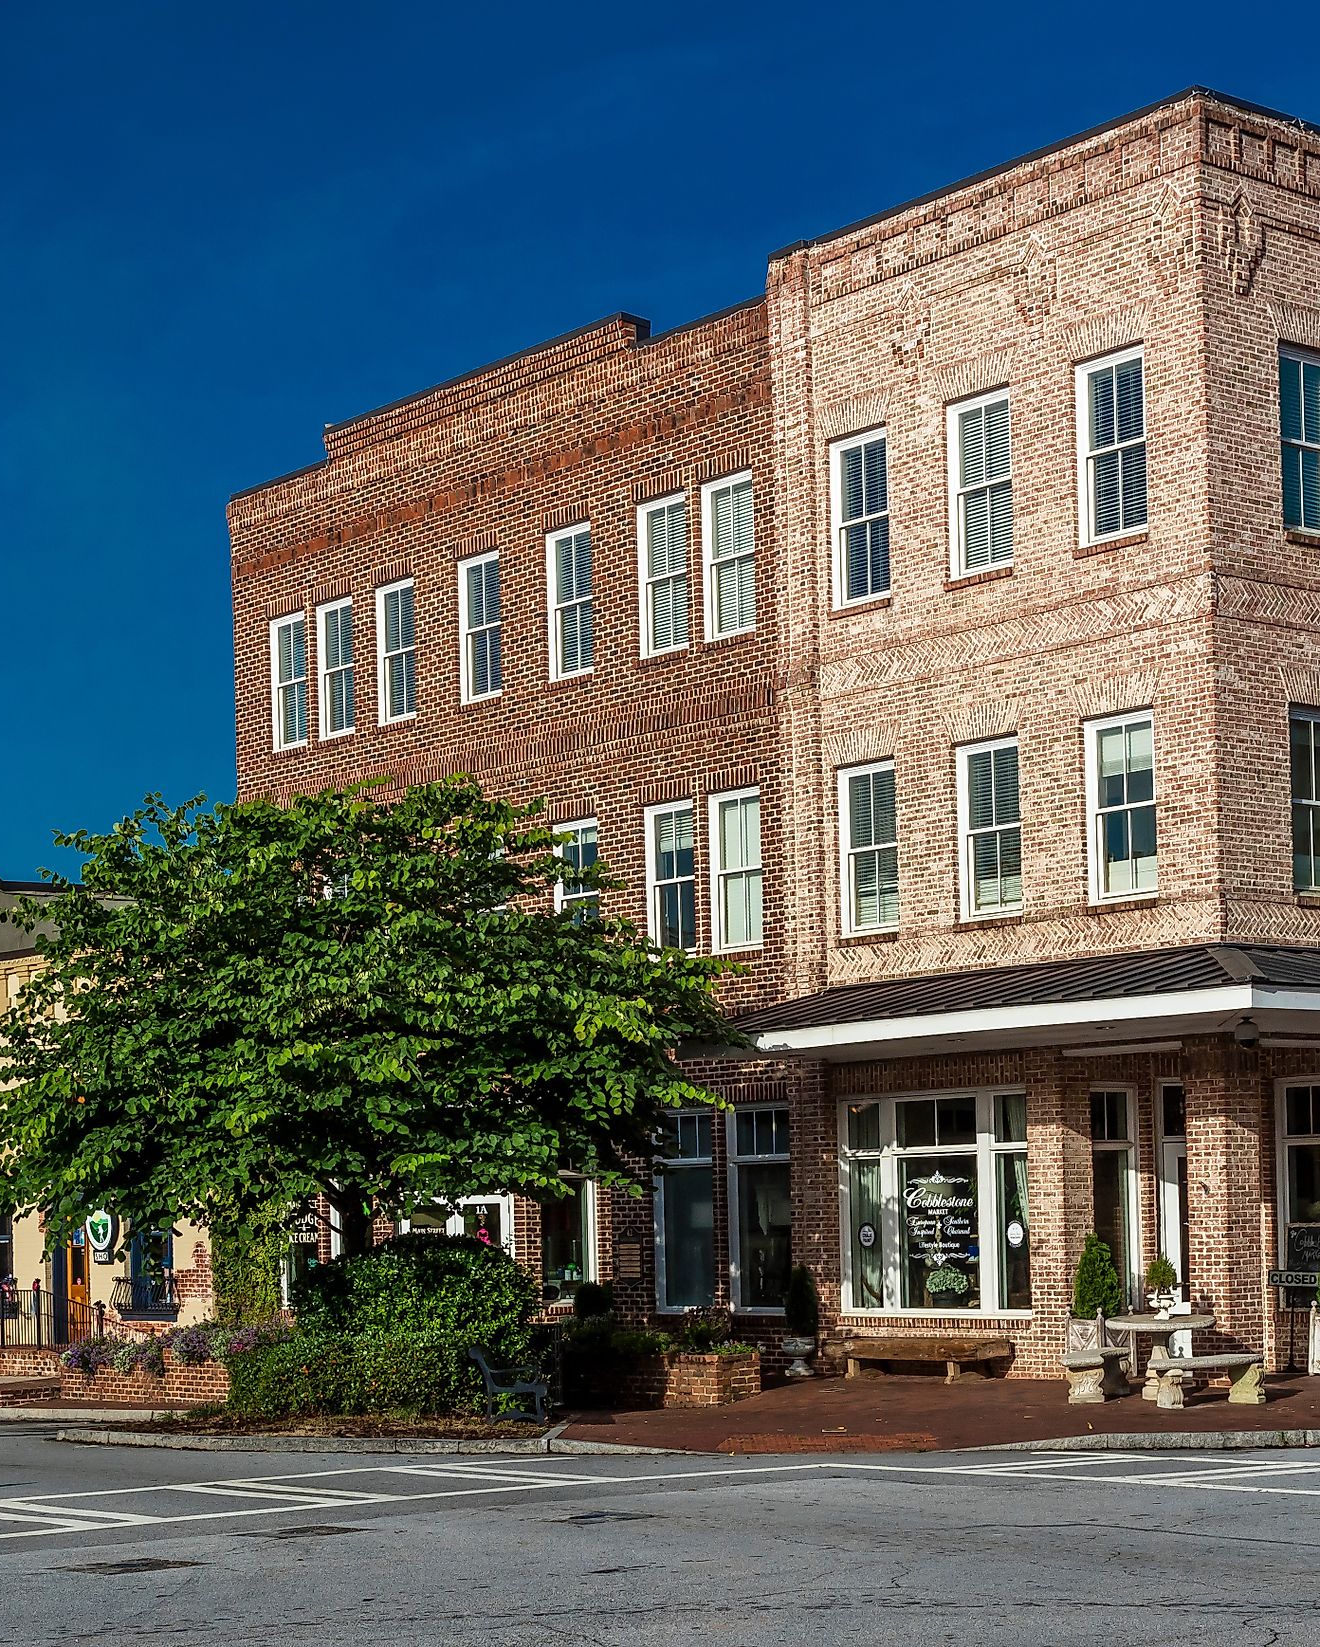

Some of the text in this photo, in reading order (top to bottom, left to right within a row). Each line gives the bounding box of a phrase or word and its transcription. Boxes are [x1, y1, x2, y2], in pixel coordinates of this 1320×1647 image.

[902, 1187, 974, 1208] Cobblestone
[475, 1205, 489, 1215] 1A
[927, 1208, 949, 1216] MARKET
[939, 1241, 960, 1250] Boutique
[1270, 1273, 1318, 1285] CLOSED
